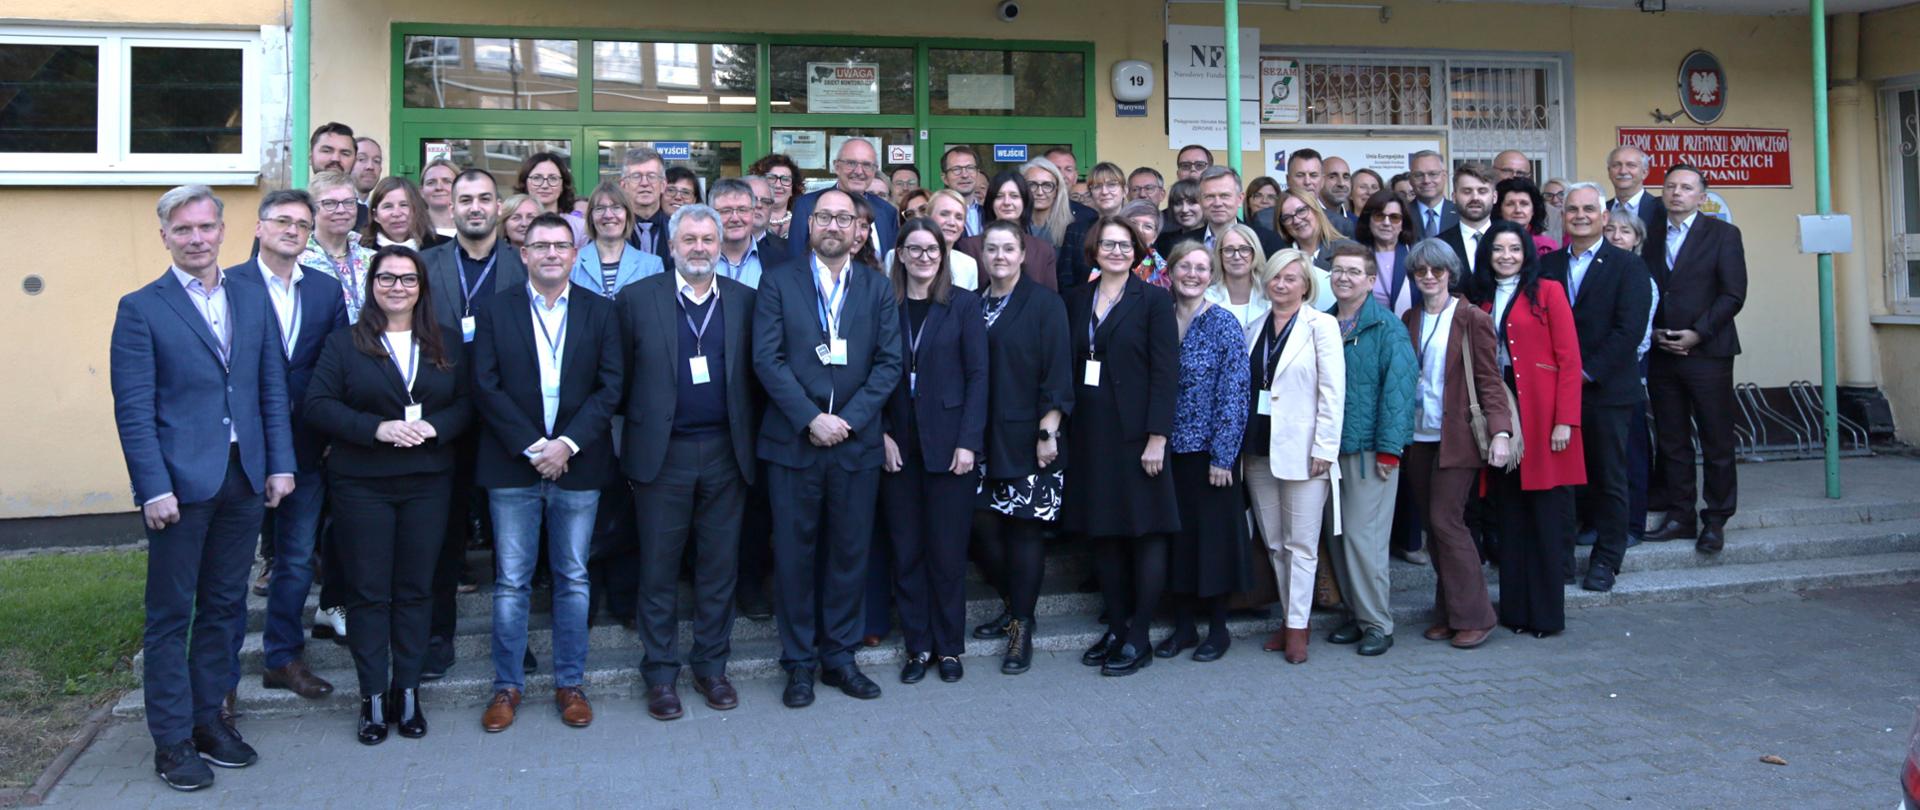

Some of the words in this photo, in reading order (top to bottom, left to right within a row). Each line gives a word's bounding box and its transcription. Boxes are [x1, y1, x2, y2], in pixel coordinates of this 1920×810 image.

[1190, 44, 1226, 68] NF
[836, 68, 874, 78] UWAGA
[1263, 67, 1297, 76] SEZAM
[1129, 75, 1145, 87] 19
[1730, 132, 1788, 152] SPOŻYWCZEGO
[656, 146, 688, 155] WYJŚCIE
[997, 147, 1025, 157] WEJŚCIE
[1701, 169, 1750, 181] ZNANIU
